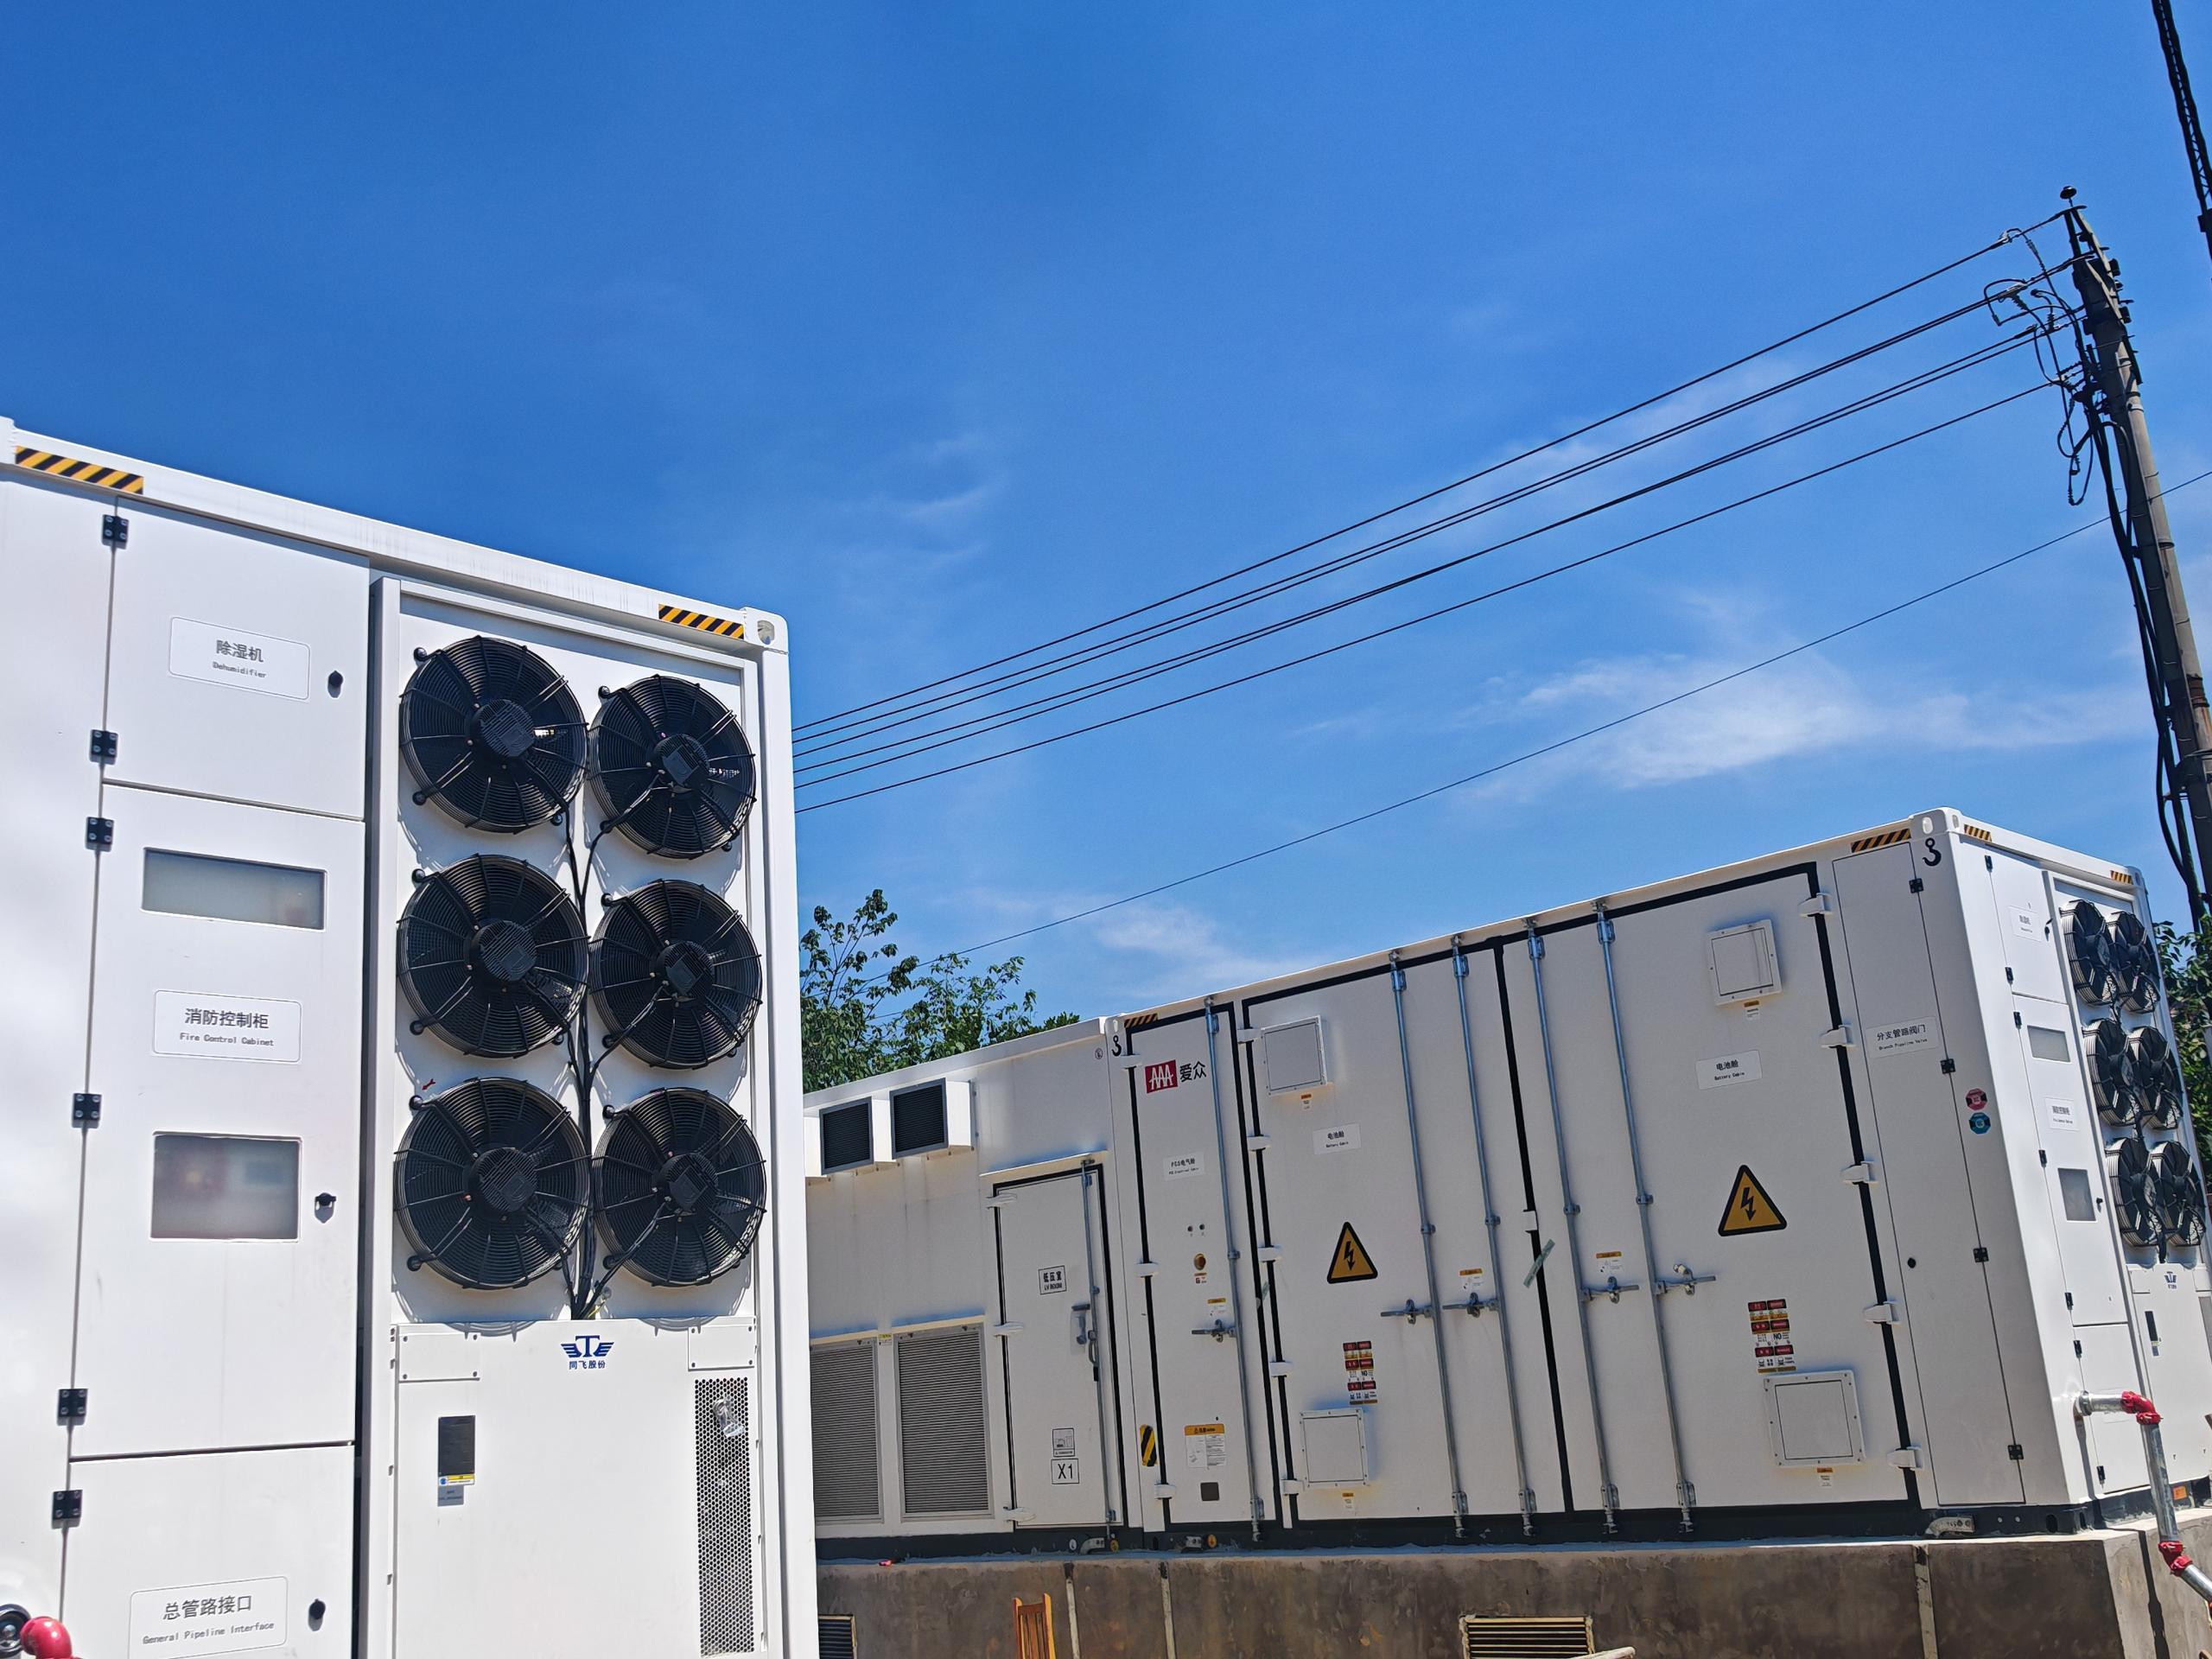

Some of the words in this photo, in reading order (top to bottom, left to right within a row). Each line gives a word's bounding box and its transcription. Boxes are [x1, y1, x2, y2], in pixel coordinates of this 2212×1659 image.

[216, 639, 264, 662] 除湿机
[213, 661, 267, 678] Dehumidifier
[185, 1007, 269, 1029] 消防控制柜
[180, 1033, 200, 1041] Fire
[203, 1034, 237, 1044] Control
[241, 1037, 274, 1046] Cabinet
[1179, 1061, 1207, 1083] 爱众
[569, 1360, 606, 1370] 同飞股份
[1058, 1463, 1073, 1479] X1
[162, 1595, 251, 1620] 总管路接口
[143, 1632, 179, 1644] General
[183, 1628, 226, 1640] Pipeline
[231, 1621, 275, 1634] Interface
